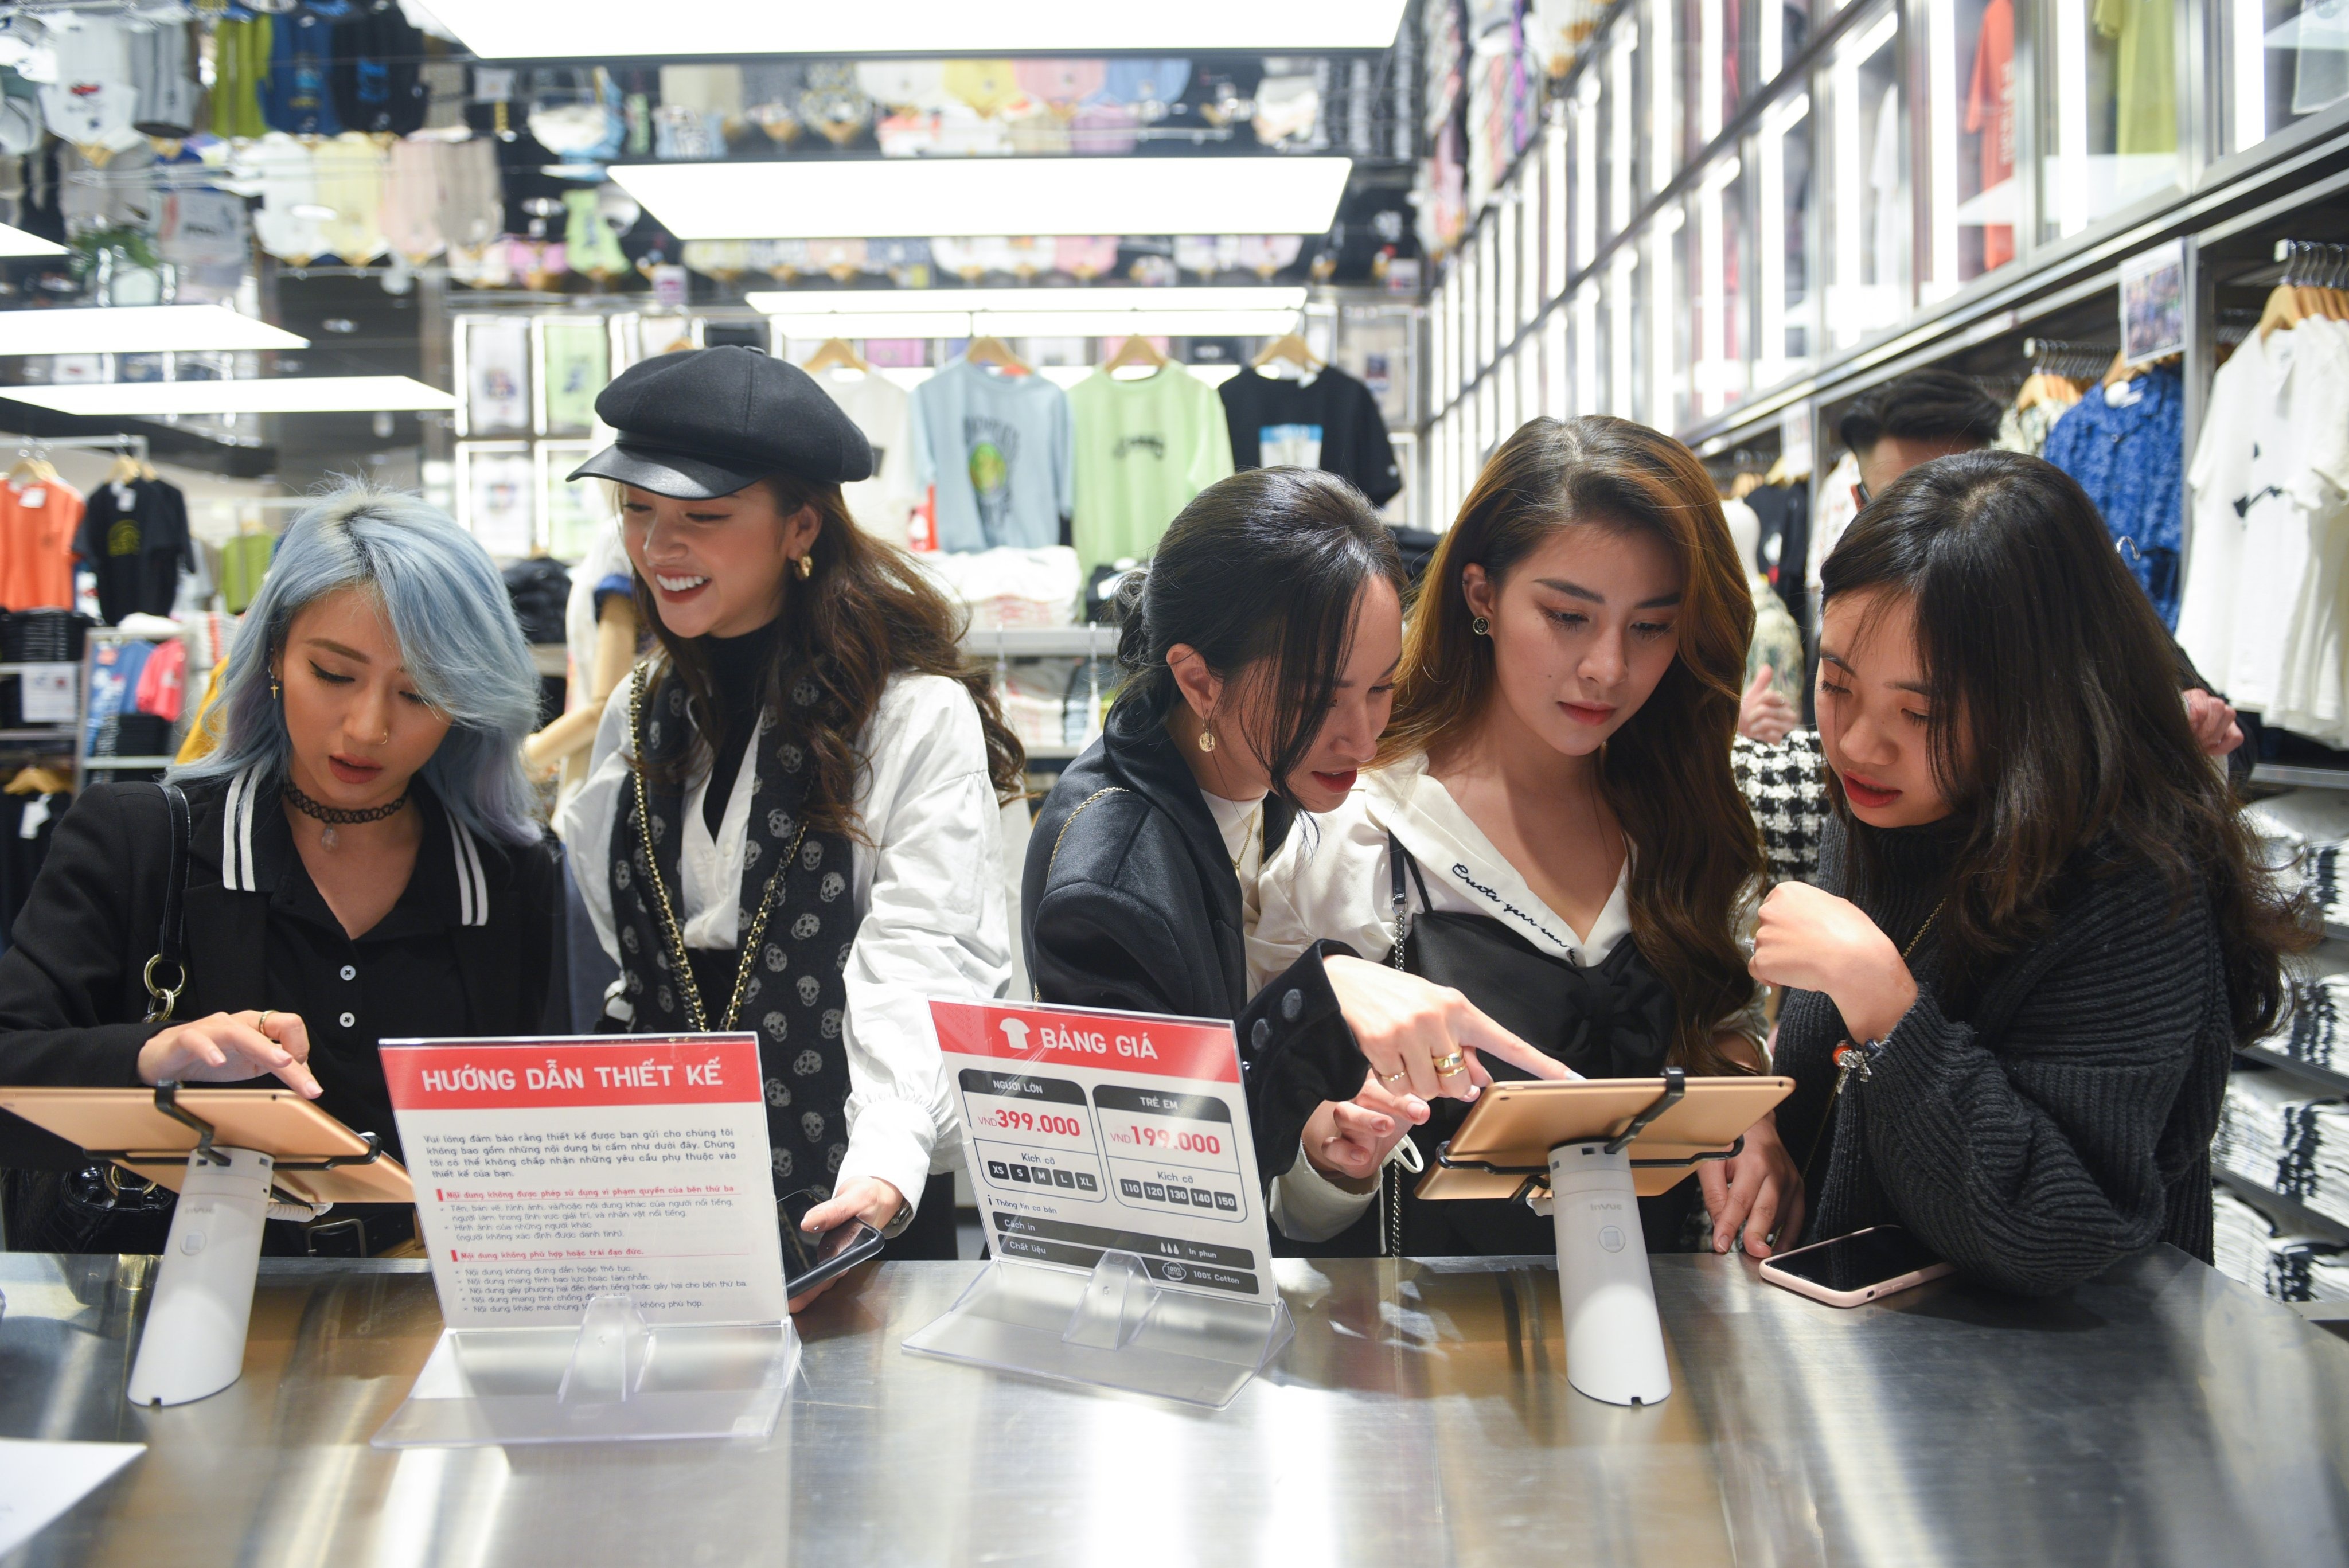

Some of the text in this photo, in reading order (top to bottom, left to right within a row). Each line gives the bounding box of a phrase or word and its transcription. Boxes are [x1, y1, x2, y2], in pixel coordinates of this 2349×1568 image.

[1452, 863, 1501, 902] Create
[1040, 1023, 1158, 1060] BẢNG GIÁ
[422, 1056, 723, 1091] HƯỚNG DẪN THIẾT KẾ
[993, 1079, 1043, 1094] NGƯỜI LỚN
[1140, 1096, 1179, 1110] TRẺ EM
[443, 1136, 465, 1144] lòng
[518, 1133, 541, 1142] rằng
[547, 1132, 568, 1140] thiết
[574, 1132, 585, 1140] kế
[591, 1132, 614, 1140] được
[620, 1132, 638, 1140] bạn
[643, 1130, 658, 1140] gửi
[686, 1129, 715, 1138] chúng
[426, 1147, 456, 1156] không
[483, 1145, 504, 1156] gồm
[509, 1146, 540, 1154] những
[545, 1145, 558, 1153] nội
[564, 1145, 587, 1153] dung
[606, 1142, 626, 1150] cấm
[704, 1140, 734, 1149] Chúng
[464, 1157, 479, 1165] thể
[485, 1158, 516, 1167] không
[521, 1156, 544, 1166] chấp
[550, 1156, 574, 1165] nhận
[580, 1156, 611, 1164] những
[616, 1154, 634, 1164] yêu
[639, 1153, 657, 1161] cầu
[662, 1153, 680, 1163] phụ
[686, 1152, 713, 1161] thuộc
[1021, 1153, 1041, 1164] Kích
[432, 1169, 452, 1177] thiết
[992, 1165, 1092, 1187] XS S M L XL
[1157, 1171, 1179, 1181] Kích
[517, 1190, 536, 1198] được
[541, 1190, 560, 1198] phép
[612, 1188, 635, 1196] phạm
[639, 1186, 664, 1195] quyền
[1123, 1183, 1234, 1207] 110 120 130 140 150
[995, 1199, 1018, 1210] Thông
[1044, 1205, 1057, 1214] bản
[1004, 1219, 1036, 1231] Cách in
[1009, 1241, 1046, 1254] Chất liệu
[1199, 1250, 1217, 1258] phun
[1193, 1270, 1239, 1284] 100% Cotton
